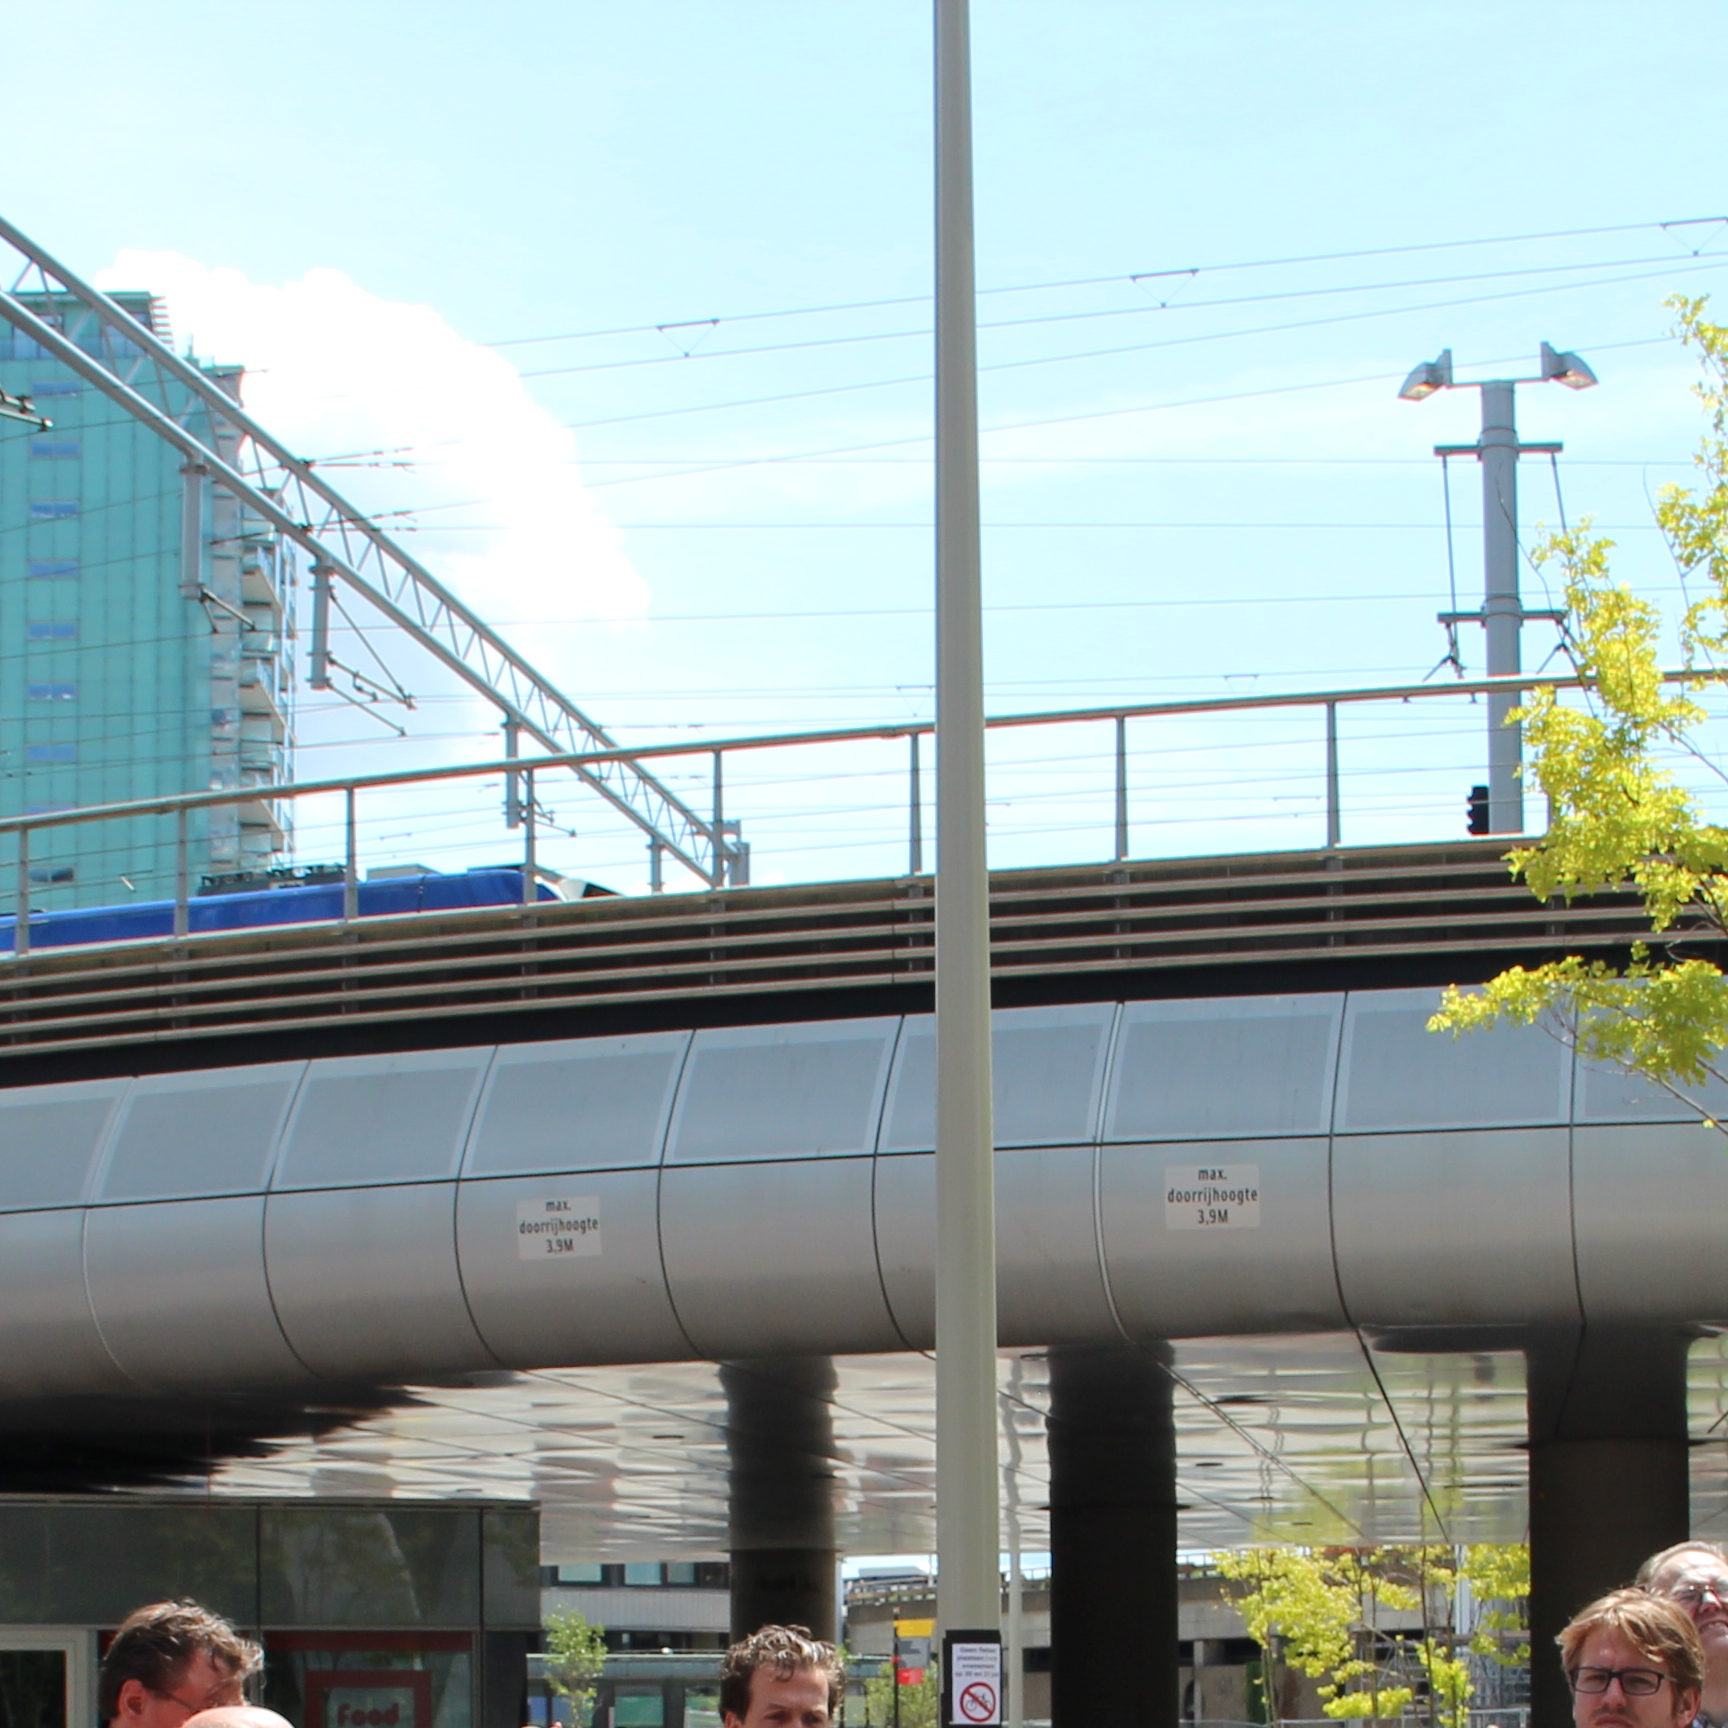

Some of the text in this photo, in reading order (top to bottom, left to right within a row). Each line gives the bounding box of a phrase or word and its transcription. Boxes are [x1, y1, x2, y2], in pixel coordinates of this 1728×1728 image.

[1197, 1169, 1227, 1181] max.
[1167, 1186, 1258, 1206] doorrijhoogte
[545, 1200, 572, 1211] max.
[1197, 1208, 1229, 1225] 3,9M
[519, 1217, 598, 1236] doorrijhoogte
[546, 1238, 574, 1253] 3,9M
